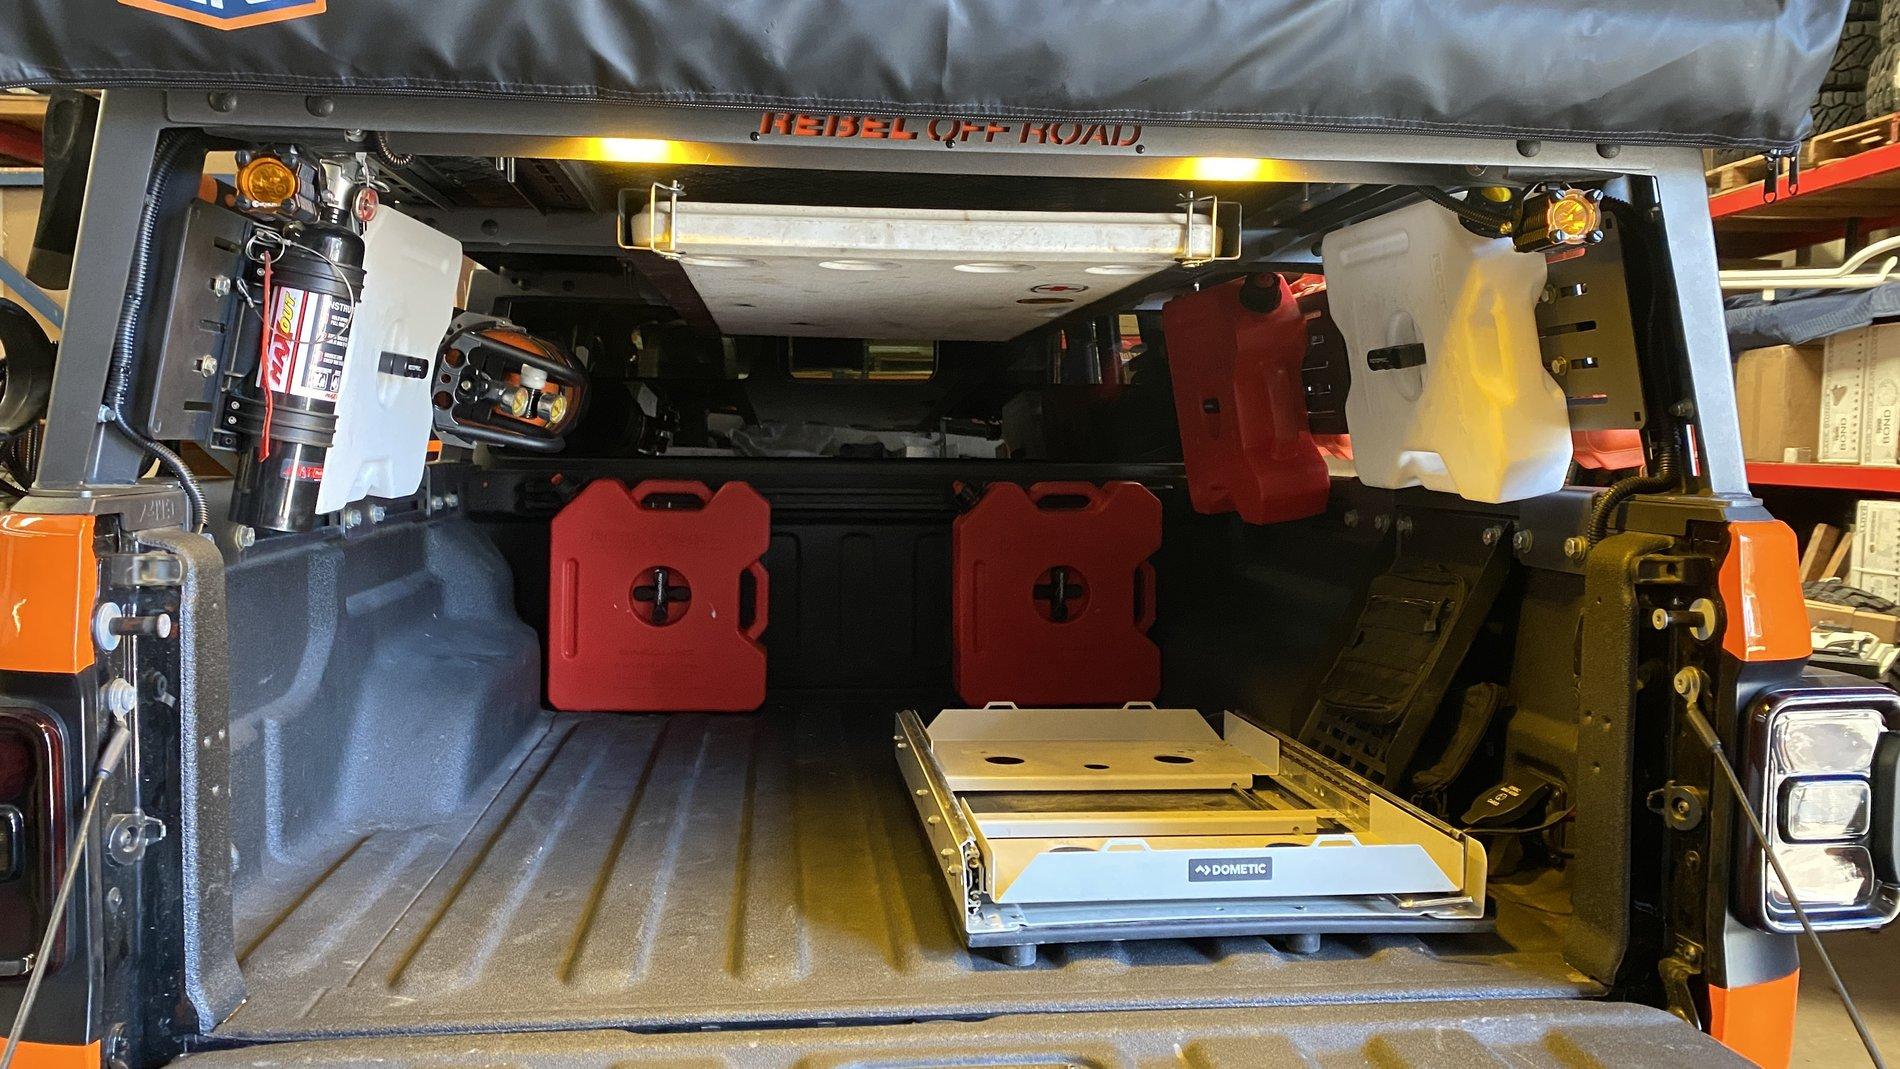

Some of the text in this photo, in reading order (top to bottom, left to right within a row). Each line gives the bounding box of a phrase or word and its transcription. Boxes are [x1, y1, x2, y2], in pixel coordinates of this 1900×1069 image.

[759, 112, 1143, 147] REBEL OFF ROAD
[1212, 863, 1267, 876] DOMETIC
